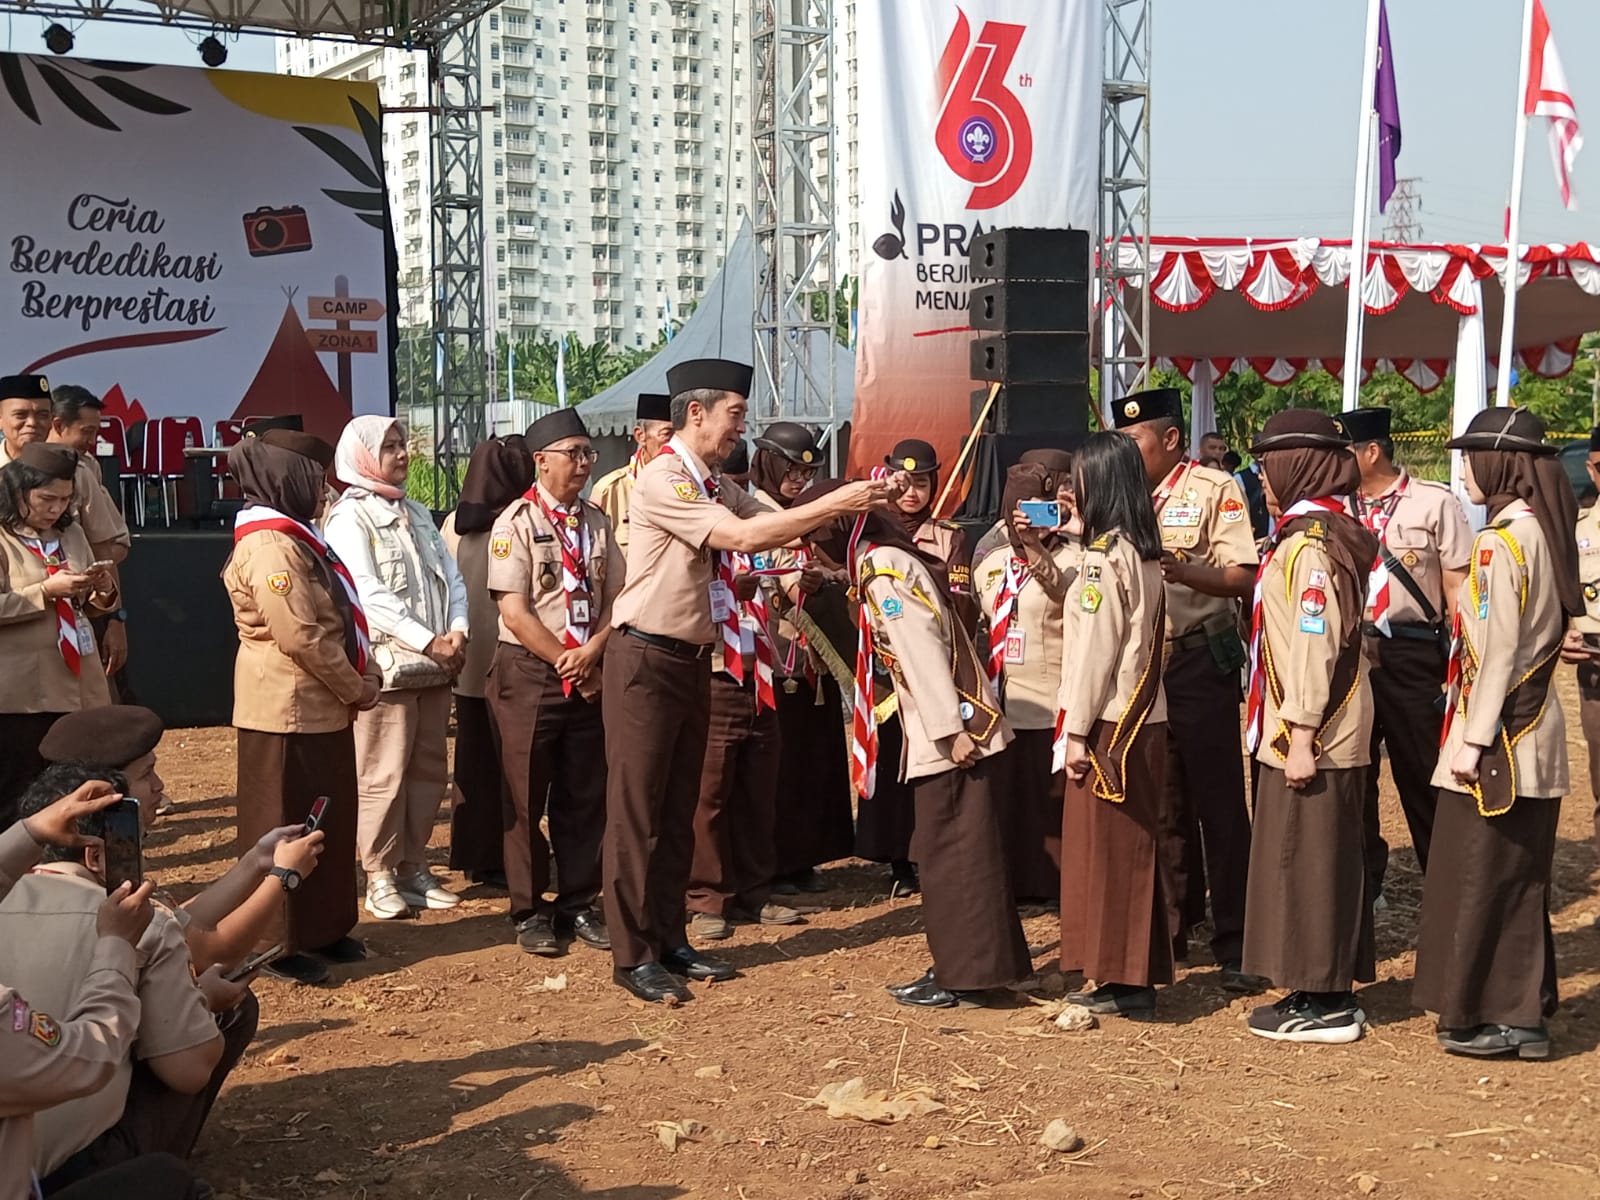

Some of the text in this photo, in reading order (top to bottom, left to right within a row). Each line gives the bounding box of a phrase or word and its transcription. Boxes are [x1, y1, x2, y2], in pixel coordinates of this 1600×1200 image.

[1018, 73, 1033, 88] th
[67, 193, 165, 234] Ceria
[916, 219, 997, 256] PRA
[10, 235, 223, 283] Berdedikasi
[21, 280, 216, 331] Berprestasi
[322, 301, 368, 314] CAMP
[915, 290, 970, 310] MENJ
[319, 335, 374, 348] ZONA 1
